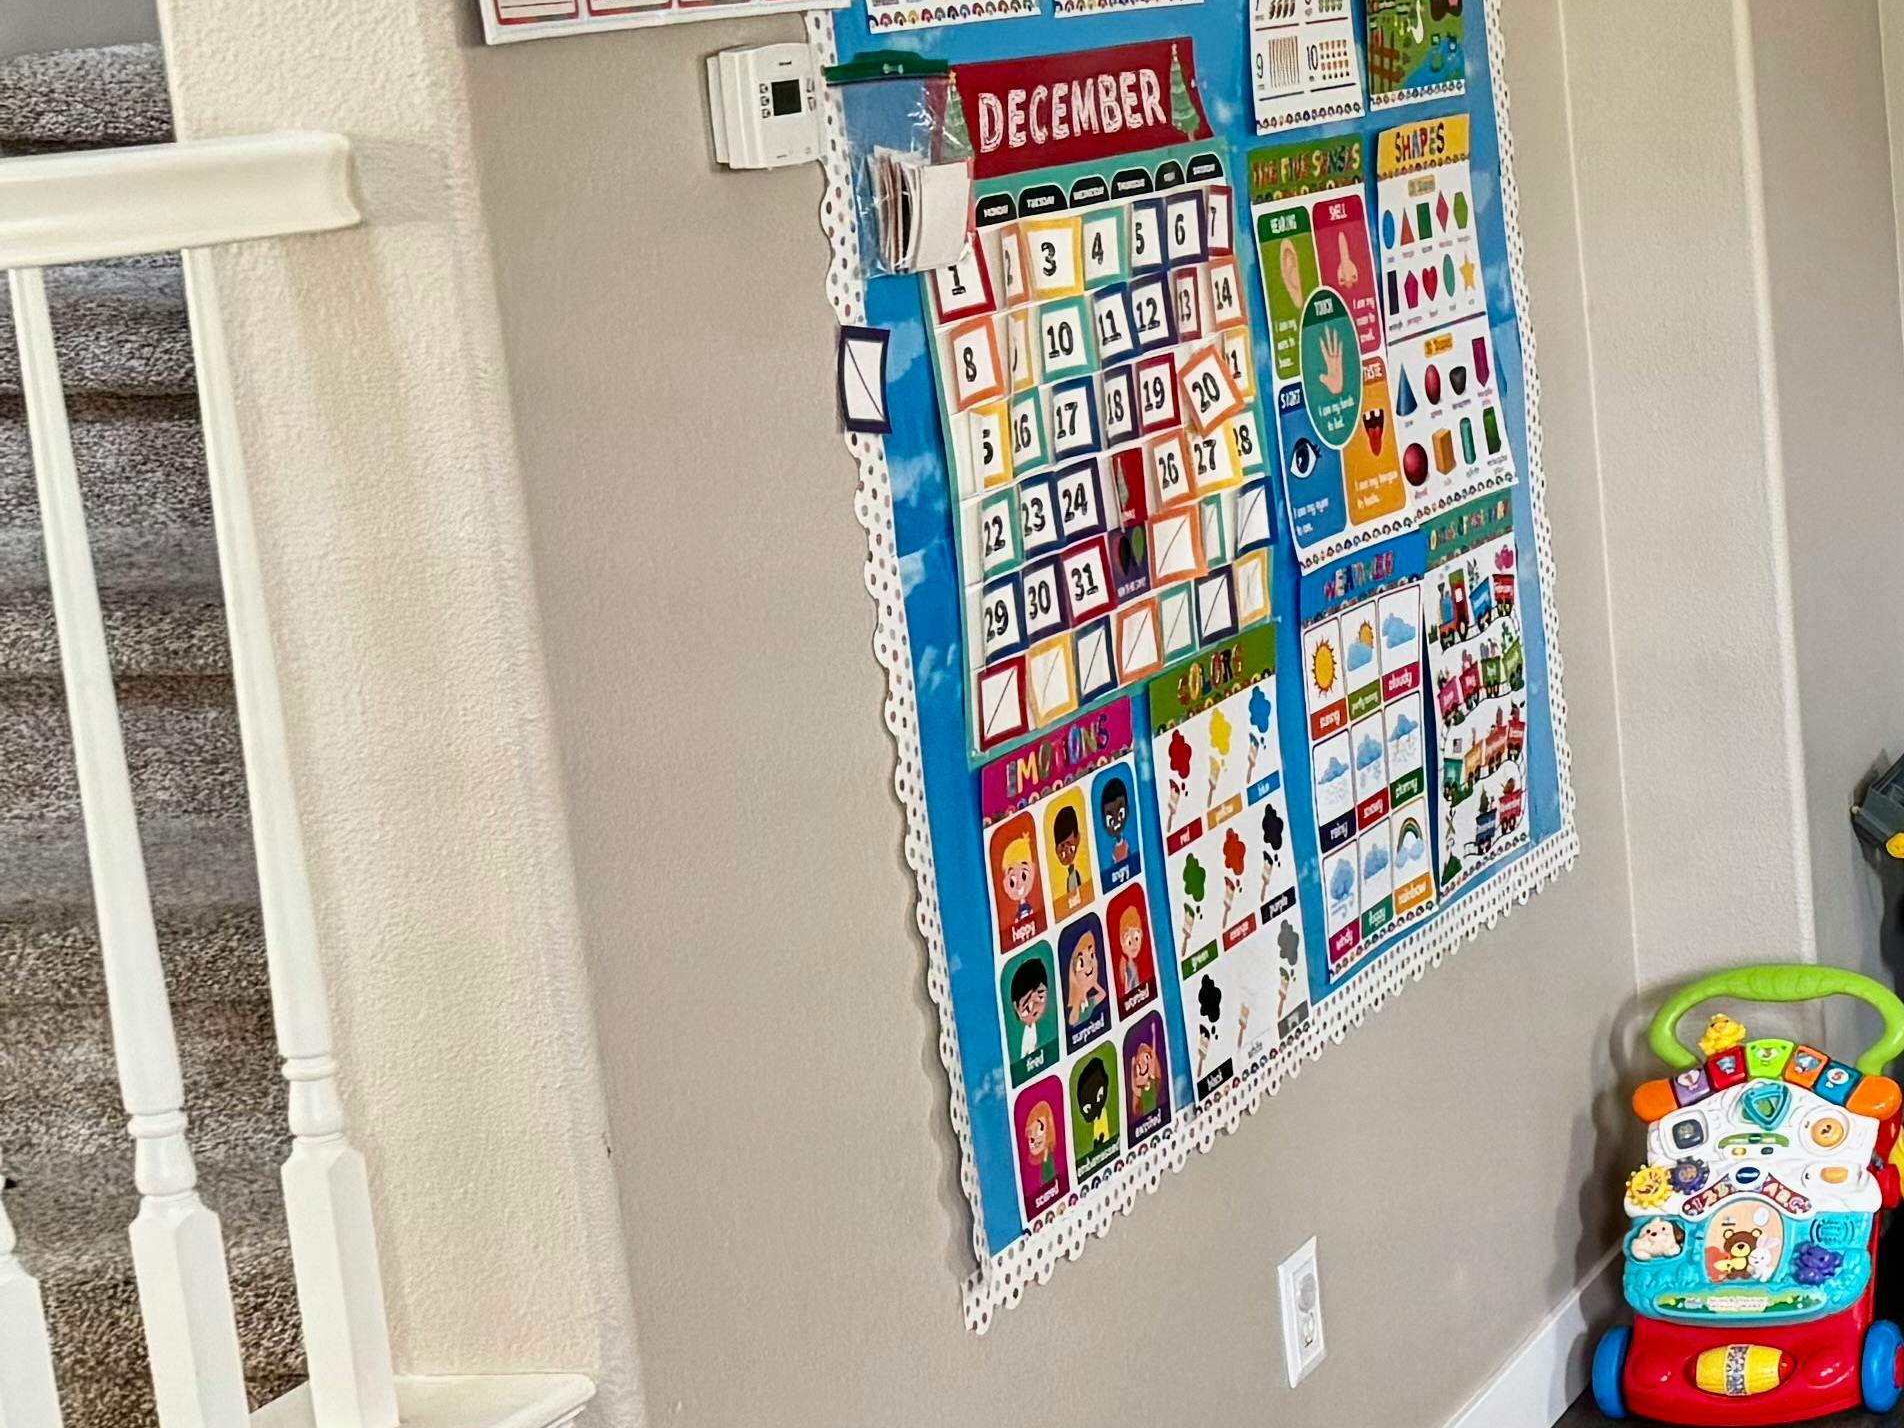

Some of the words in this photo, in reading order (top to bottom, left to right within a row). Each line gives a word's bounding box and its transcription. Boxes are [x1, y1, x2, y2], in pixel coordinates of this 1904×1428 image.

[978, 68, 1167, 154] DECEMBER
[1395, 122, 1445, 164] SHAPES
[1174, 213, 1185, 245] 6
[1041, 241, 1057, 277] 3
[1091, 232, 1104, 265] 4
[1214, 276, 1232, 310] 14
[1098, 309, 1121, 346] 11
[1135, 296, 1161, 332] 12
[1046, 321, 1075, 358] 10
[963, 346, 977, 383] 8
[1142, 376, 1165, 412] 19
[1192, 371, 1221, 414] 20
[1014, 414, 1031, 453] 16
[1056, 401, 1078, 439] 17
[1158, 452, 1179, 490] 26
[1193, 438, 1217, 475] 27
[1062, 483, 1088, 523] 24
[983, 515, 1006, 558] 22
[1027, 580, 1051, 620] 30
[1071, 562, 1099, 601] 31
[984, 598, 1009, 643] 29
[1177, 643, 1243, 706] COLORS
[1005, 713, 1109, 799] EMOTIONS
[1124, 986, 1150, 1012] worried
[1026, 1049, 1045, 1073] tired
[1035, 1180, 1060, 1209] scared
